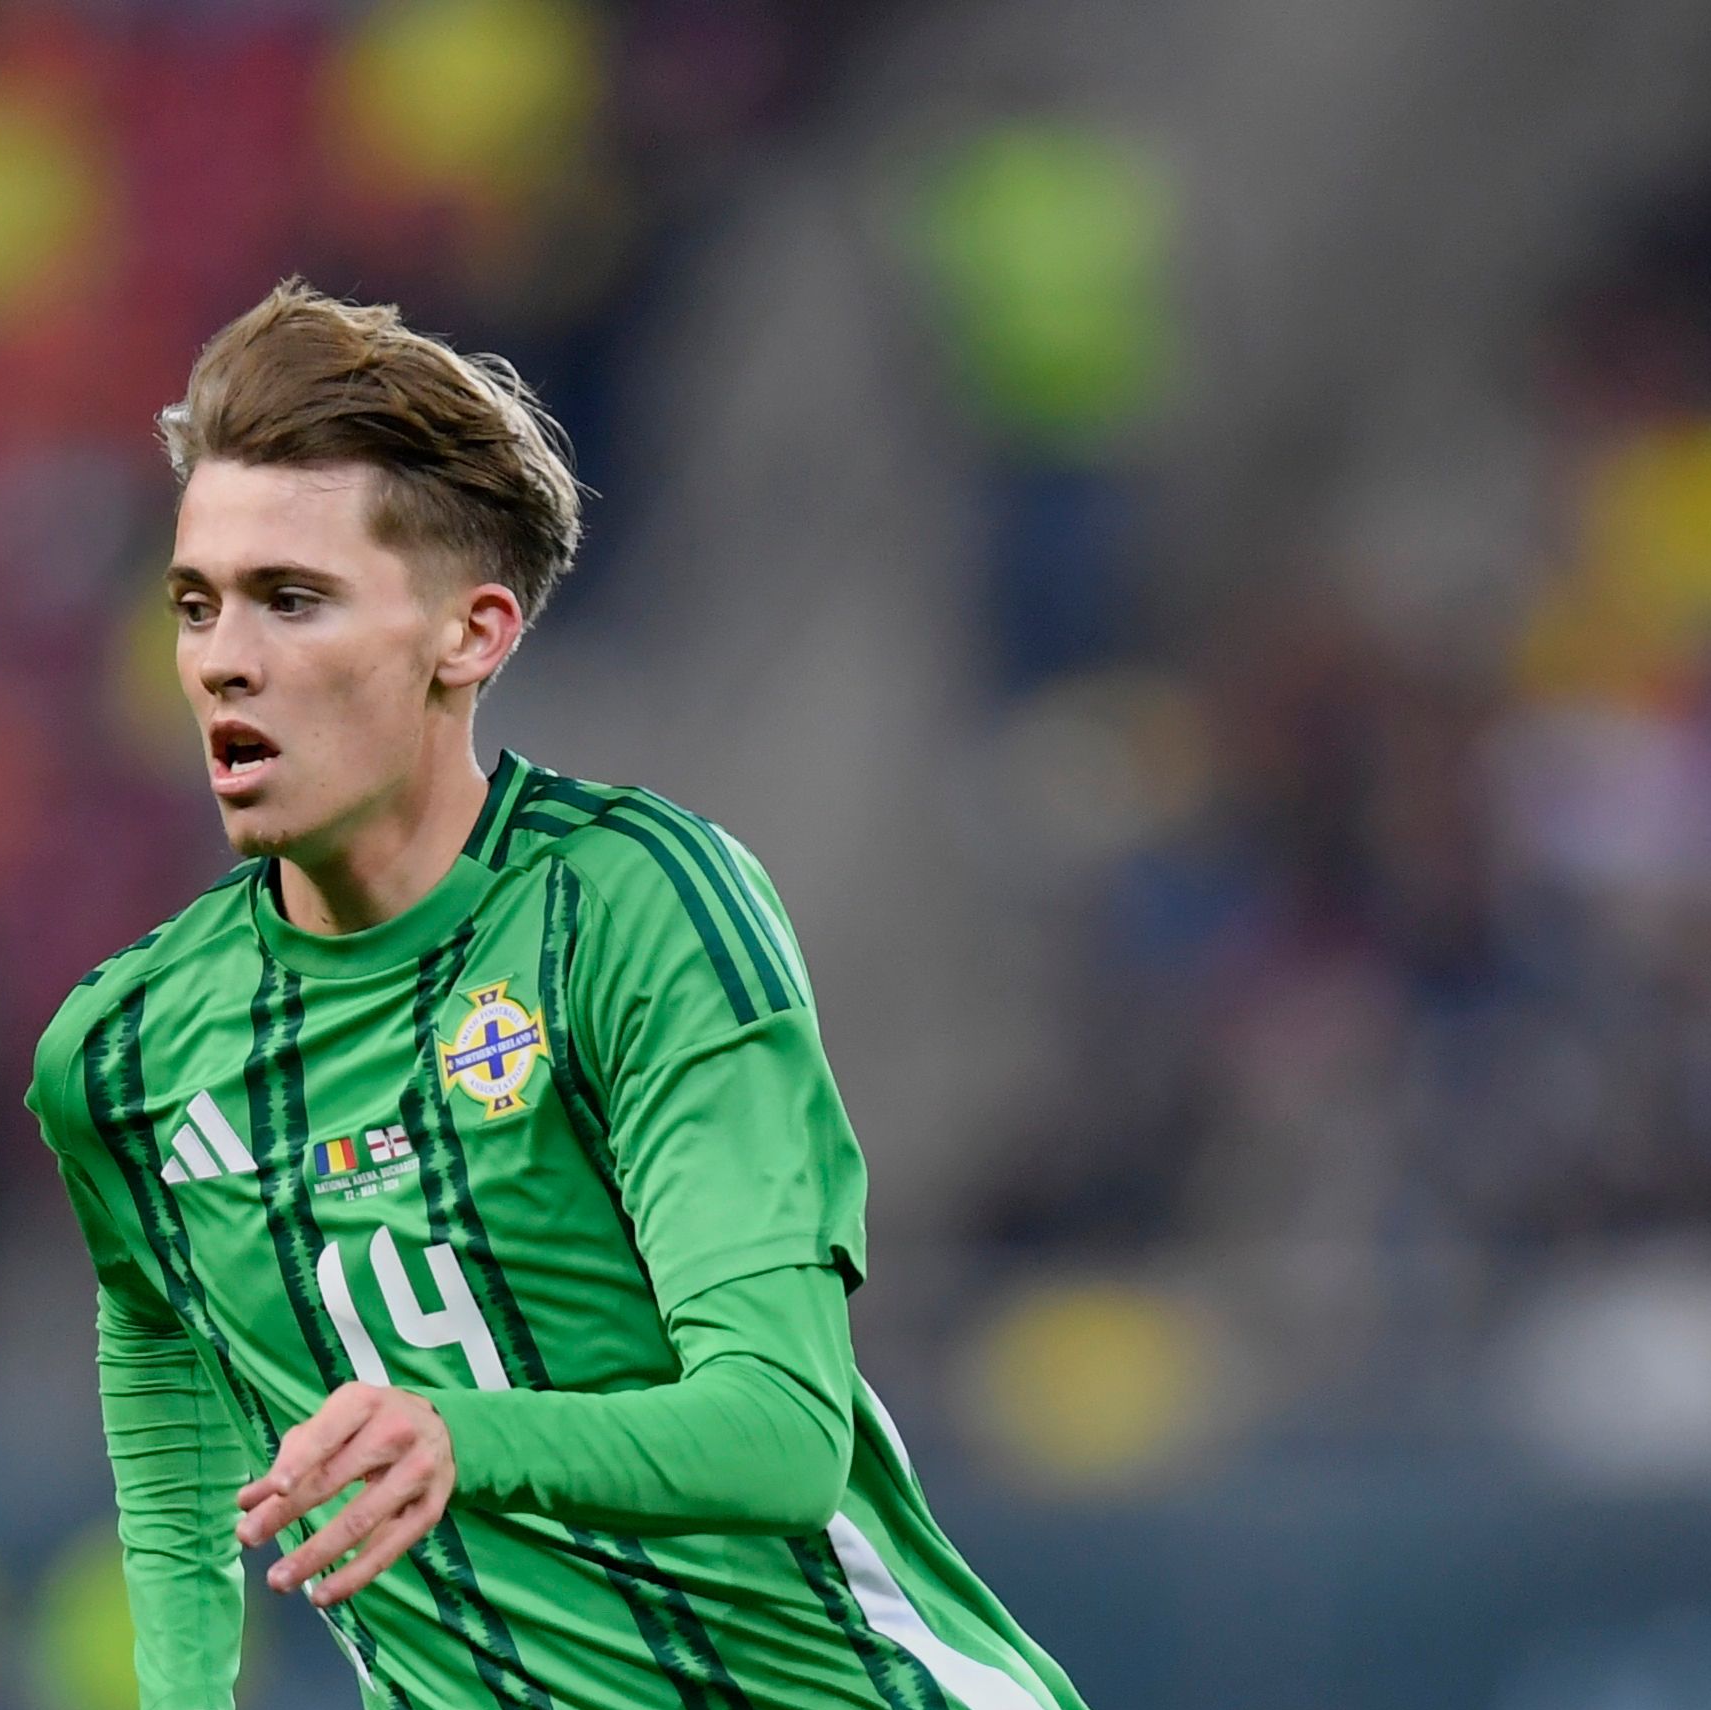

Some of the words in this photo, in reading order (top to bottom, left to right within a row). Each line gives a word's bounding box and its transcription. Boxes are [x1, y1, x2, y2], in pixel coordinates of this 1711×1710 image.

[454, 1045, 497, 1068] NORTHERN
[498, 1031, 532, 1053] IRELAND
[314, 1178, 351, 1194] NATIONAL
[317, 1224, 512, 1391] 14
